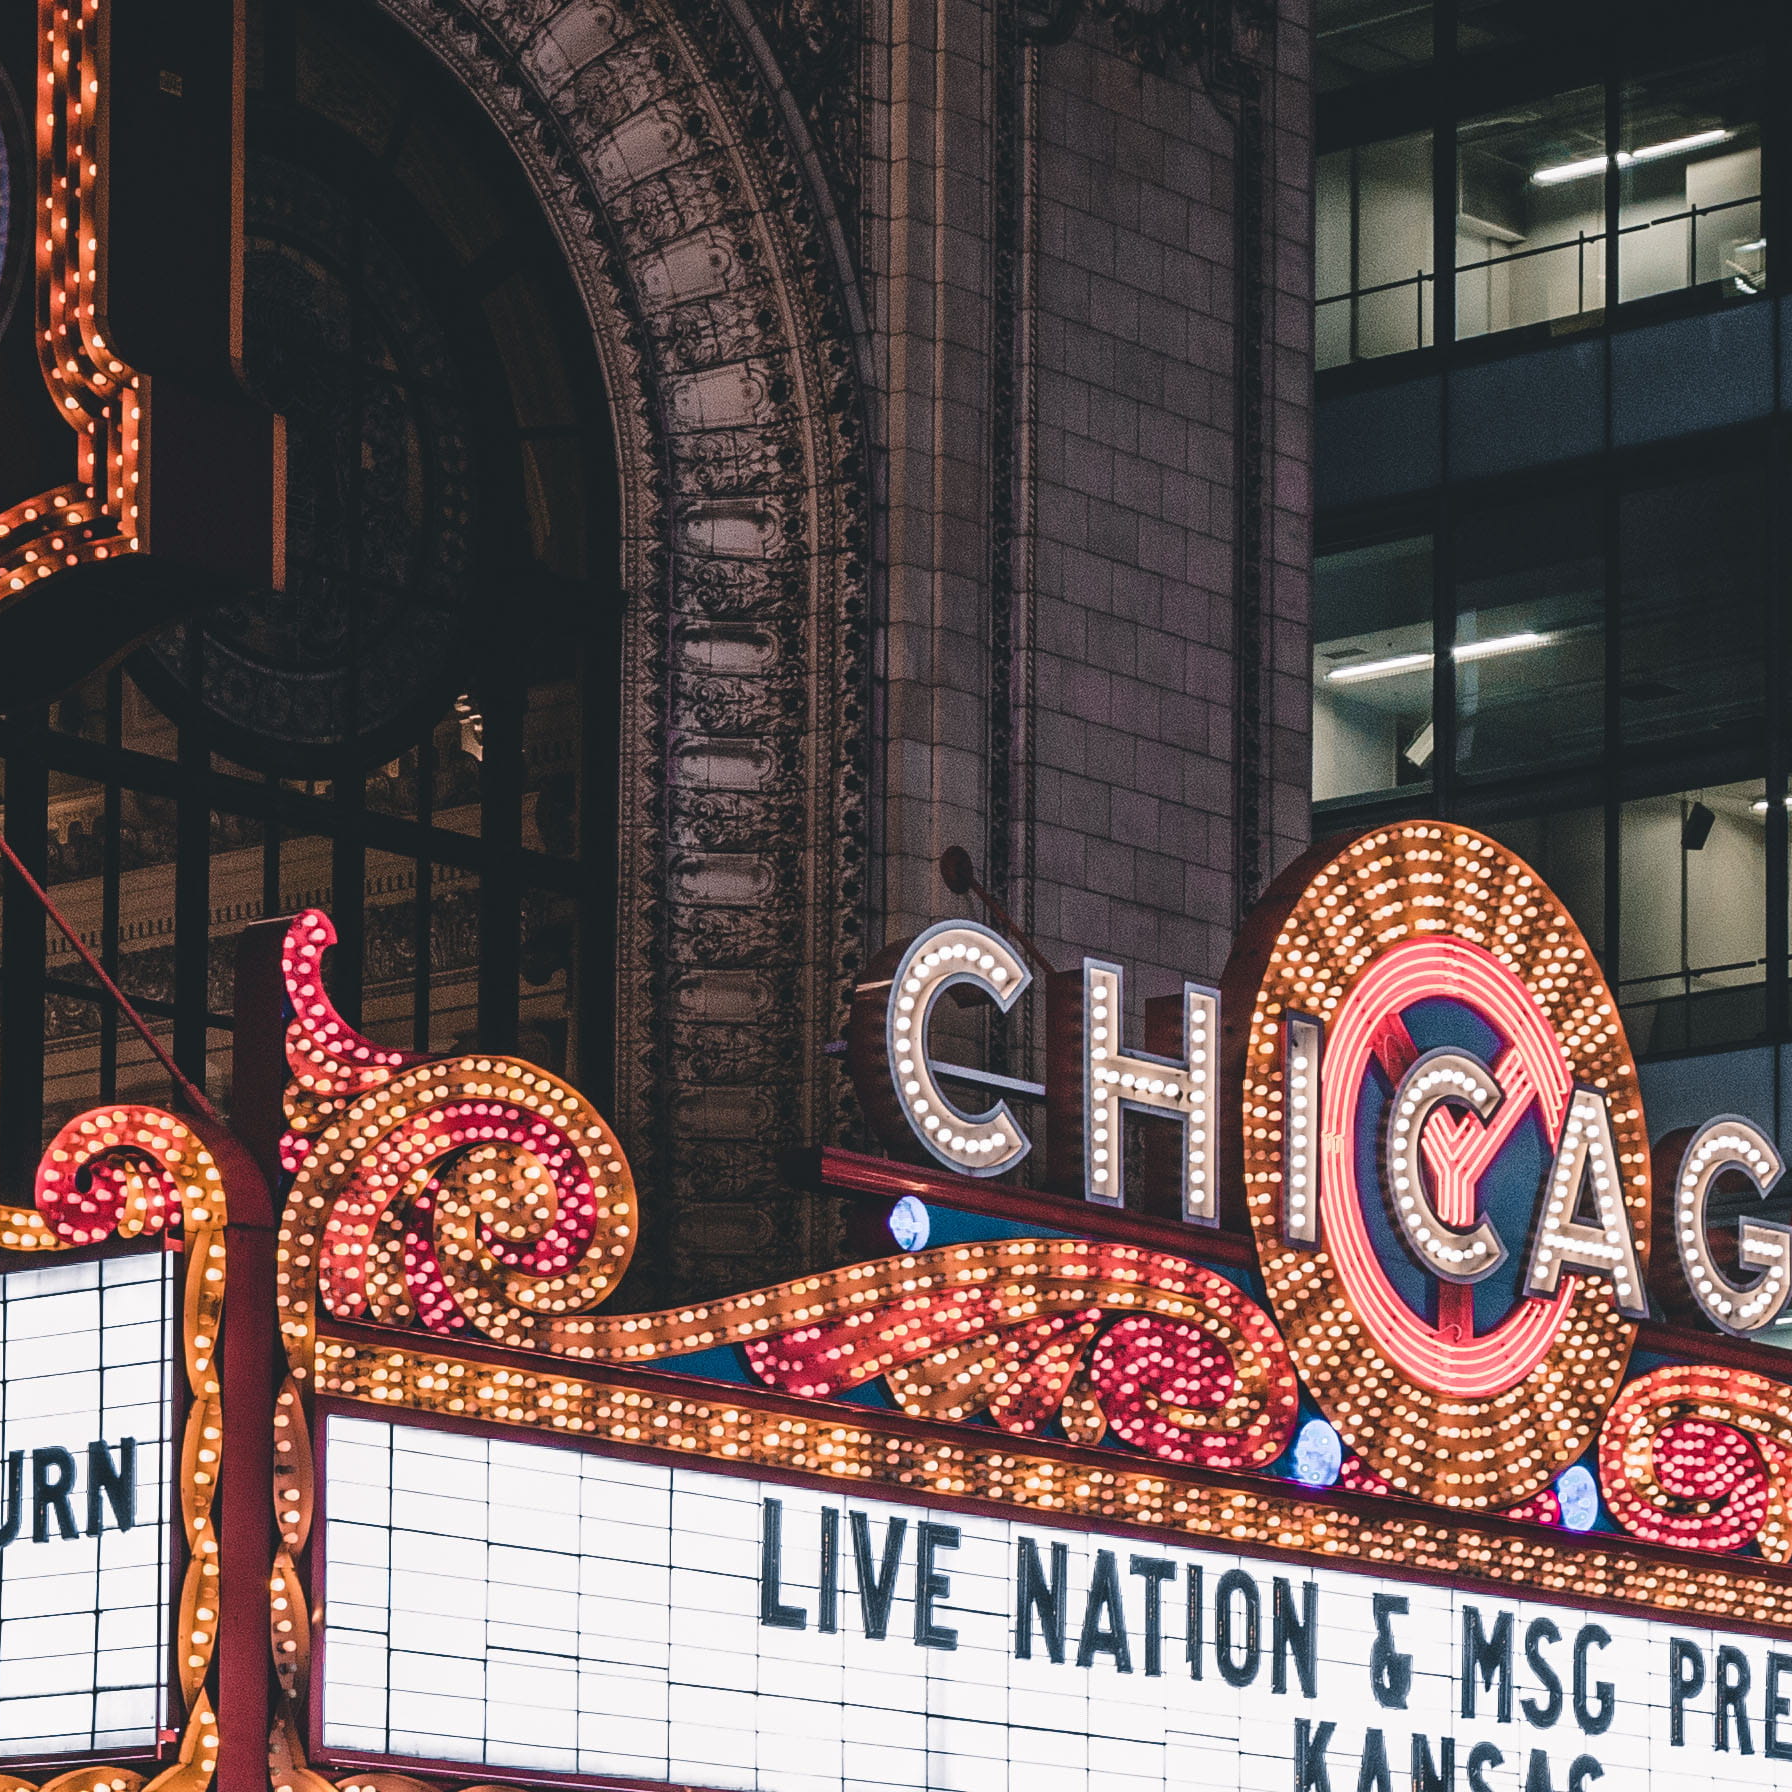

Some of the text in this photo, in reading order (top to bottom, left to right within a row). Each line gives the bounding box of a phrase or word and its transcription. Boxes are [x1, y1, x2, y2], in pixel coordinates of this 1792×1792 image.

[760, 1497, 960, 1651] LIVE
[1013, 1536, 1319, 1699] NATION
[1371, 1592, 1411, 1710] &
[1462, 1604, 1612, 1737] MSG
